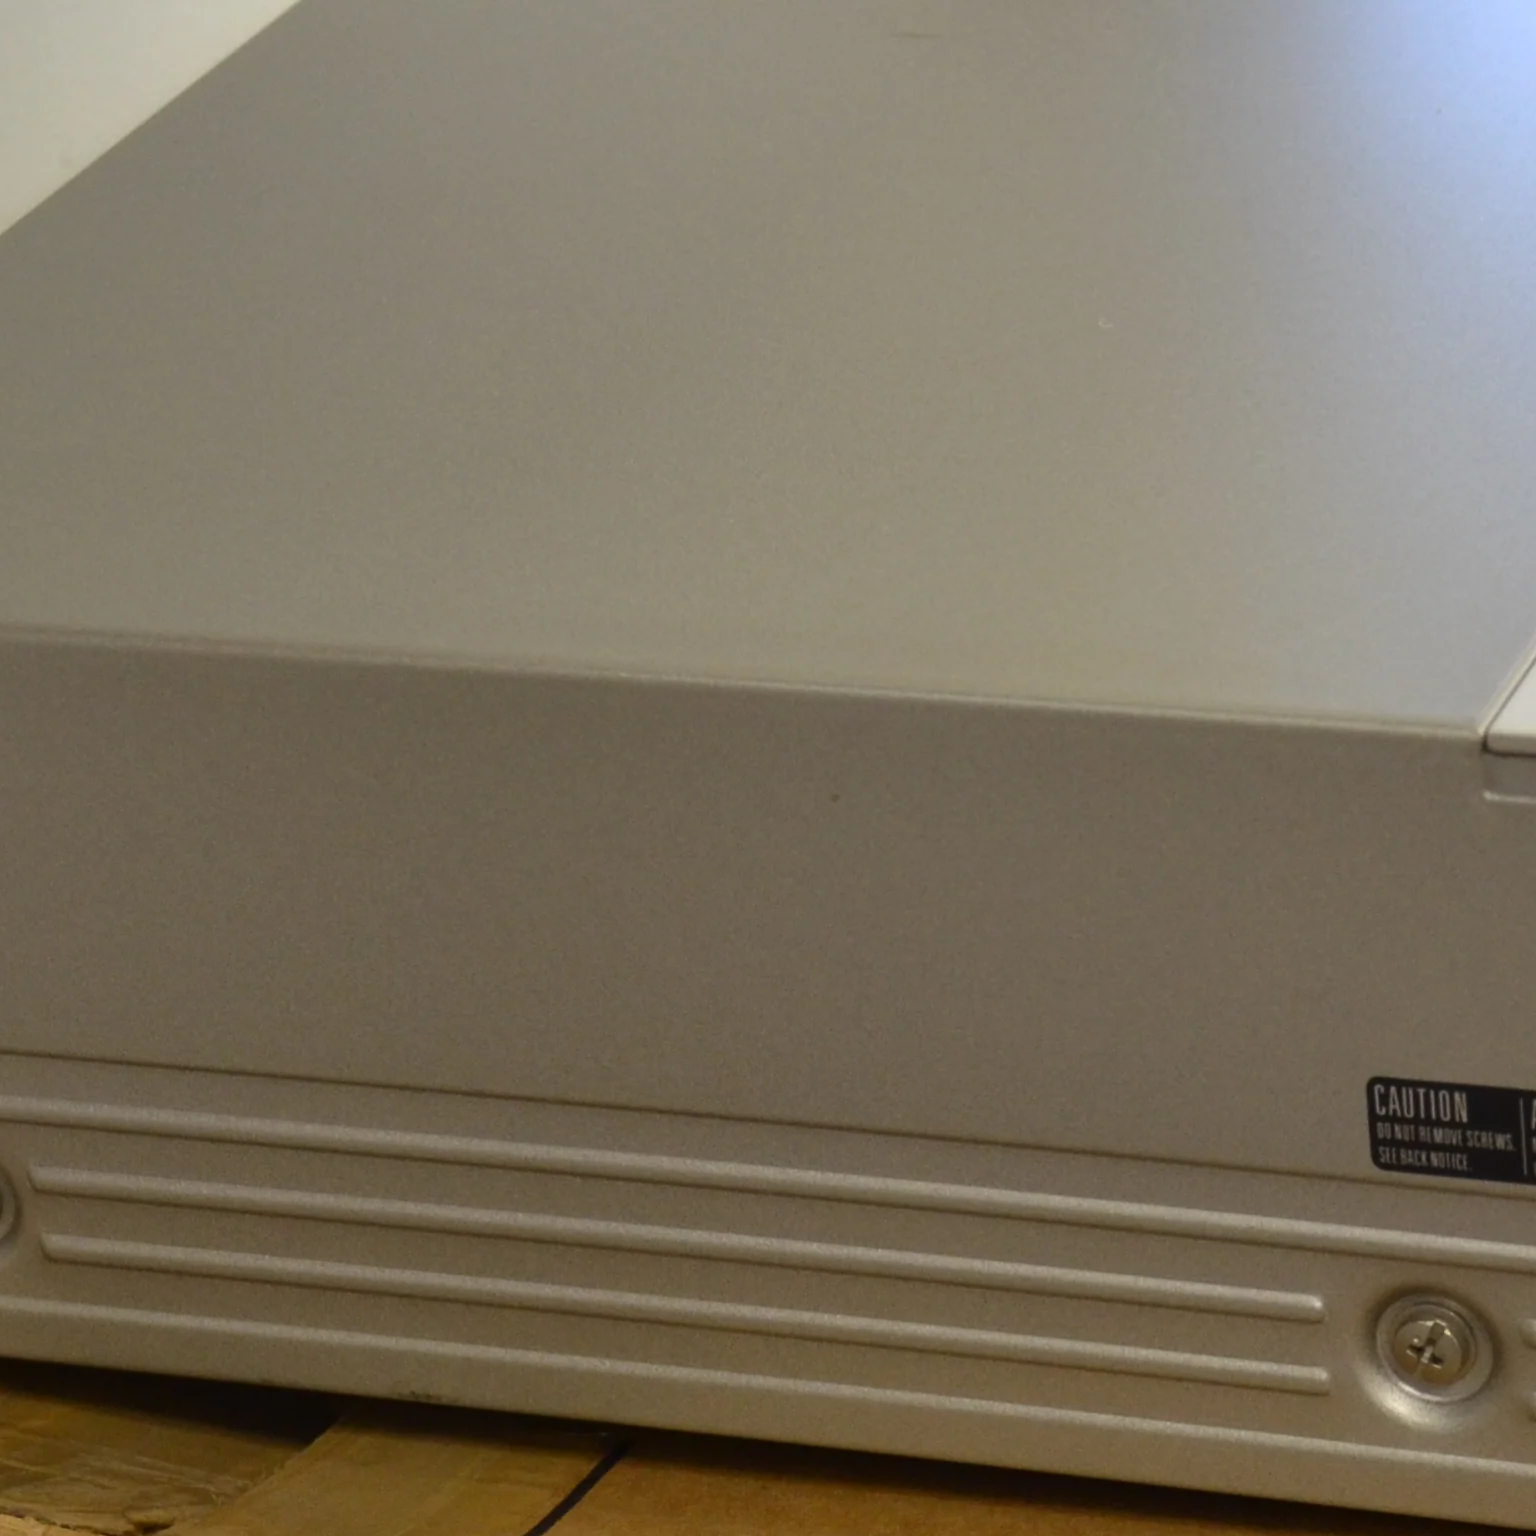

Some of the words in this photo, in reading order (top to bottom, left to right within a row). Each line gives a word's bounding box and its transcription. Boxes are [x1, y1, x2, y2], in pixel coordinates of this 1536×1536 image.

[1373, 1084, 1468, 1123] CAUTION
[1376, 1122, 1392, 1139] DO
[1394, 1123, 1415, 1141] NOT
[1418, 1126, 1462, 1147] REMOVE
[1466, 1130, 1516, 1151] SCREWS.
[1378, 1146, 1397, 1165] SEE
[1400, 1148, 1428, 1167] BACK
